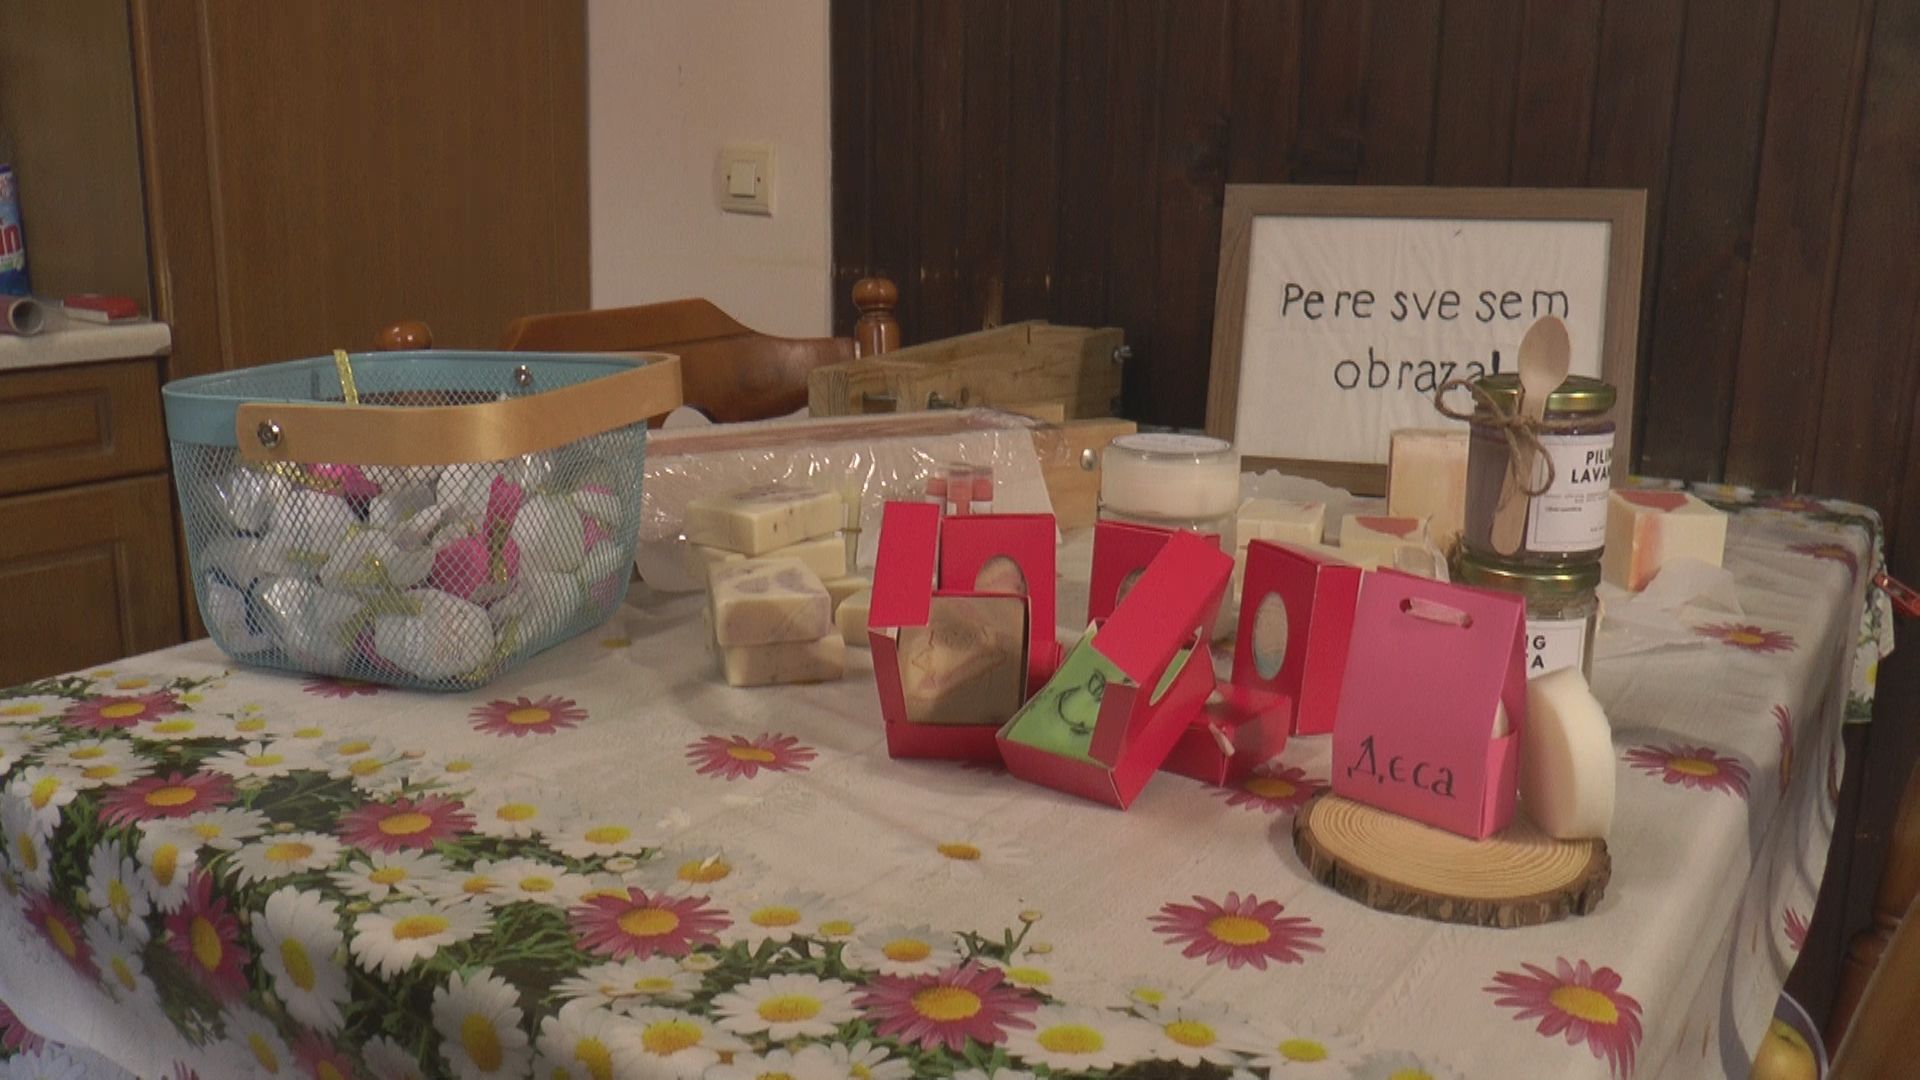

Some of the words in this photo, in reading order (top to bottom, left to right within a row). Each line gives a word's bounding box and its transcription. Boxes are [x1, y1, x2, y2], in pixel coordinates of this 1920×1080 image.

[1282, 283, 1375, 320] Pere
[1390, 289, 1461, 321] sve
[1475, 289, 1570, 323] sem
